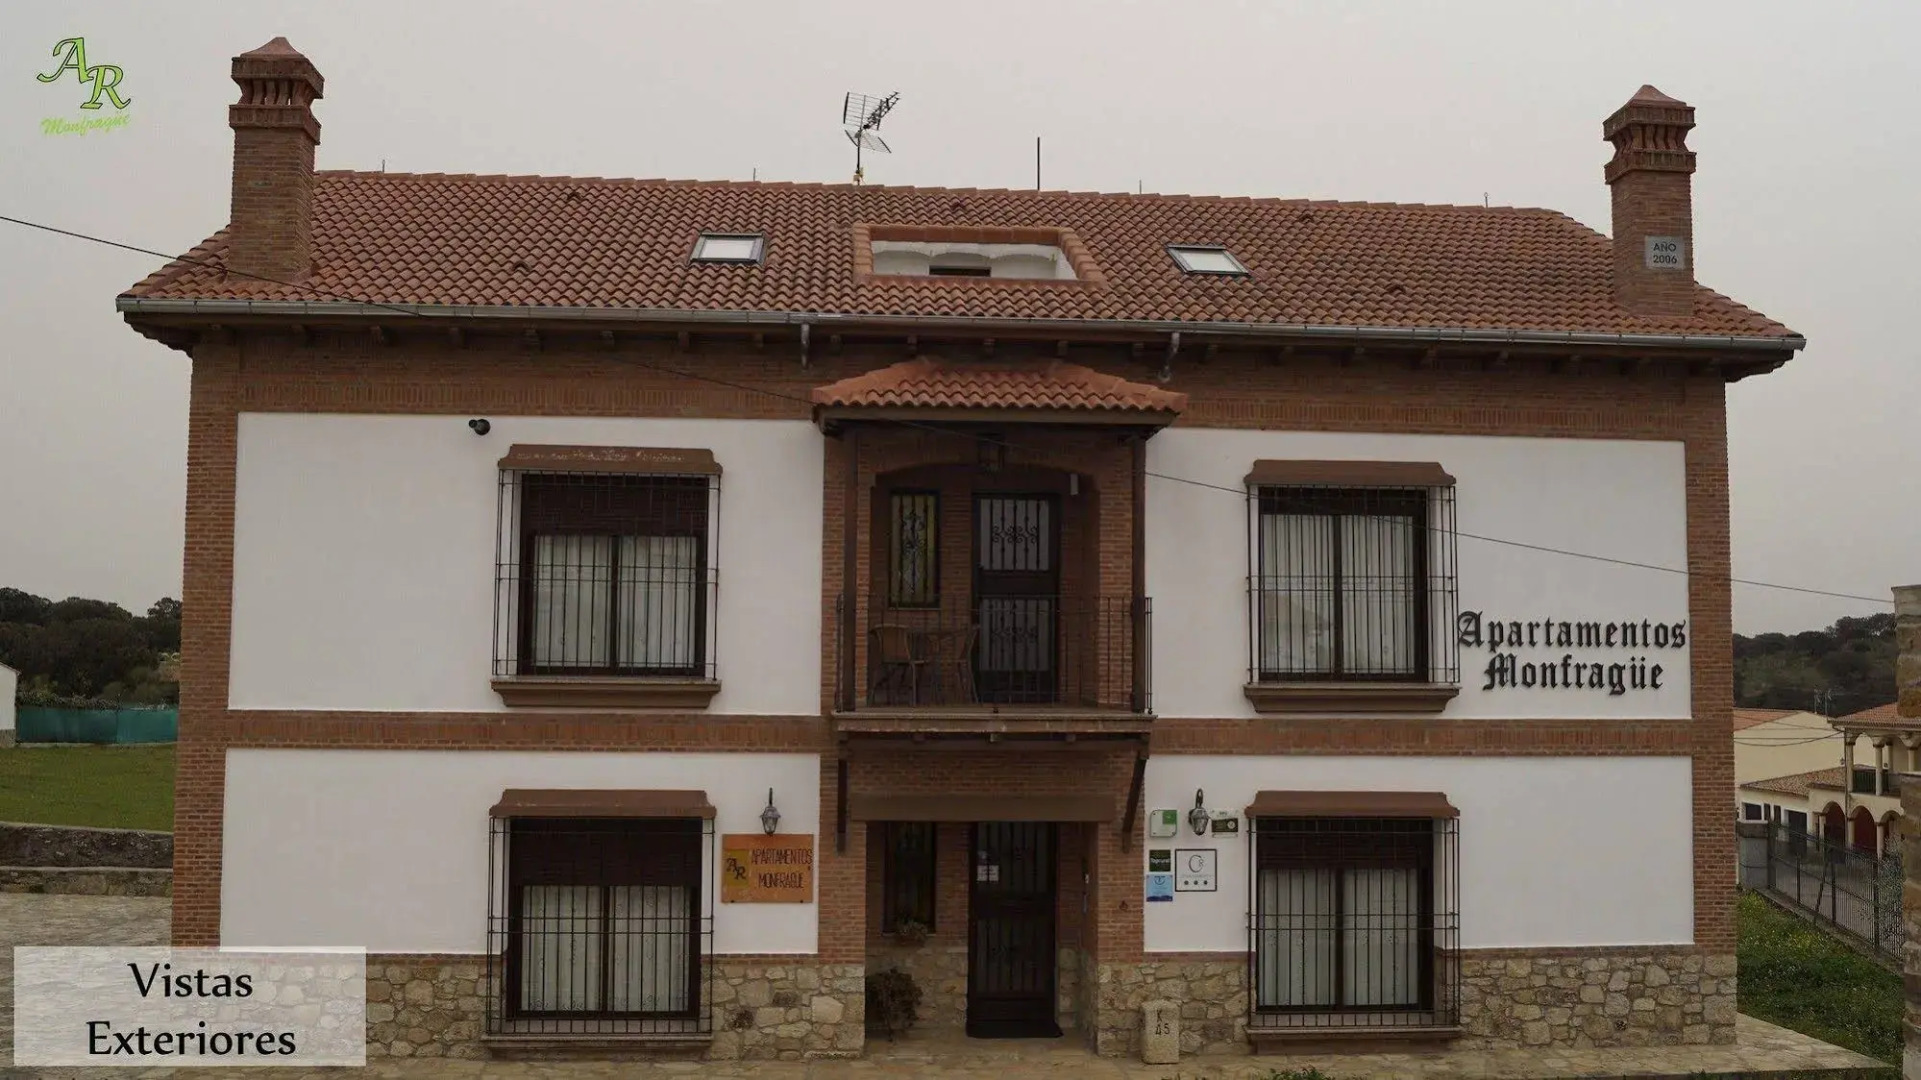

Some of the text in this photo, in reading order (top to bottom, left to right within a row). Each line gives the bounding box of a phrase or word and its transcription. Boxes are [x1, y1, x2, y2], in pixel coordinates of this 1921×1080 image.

[1653, 241, 1676, 252] AÑO
[1653, 254, 1677, 264] 2006
[1457, 610, 1686, 653] Apartamentos
[1482, 652, 1663, 695] Monfragüe
[751, 848, 813, 865] APARTAMENTOS
